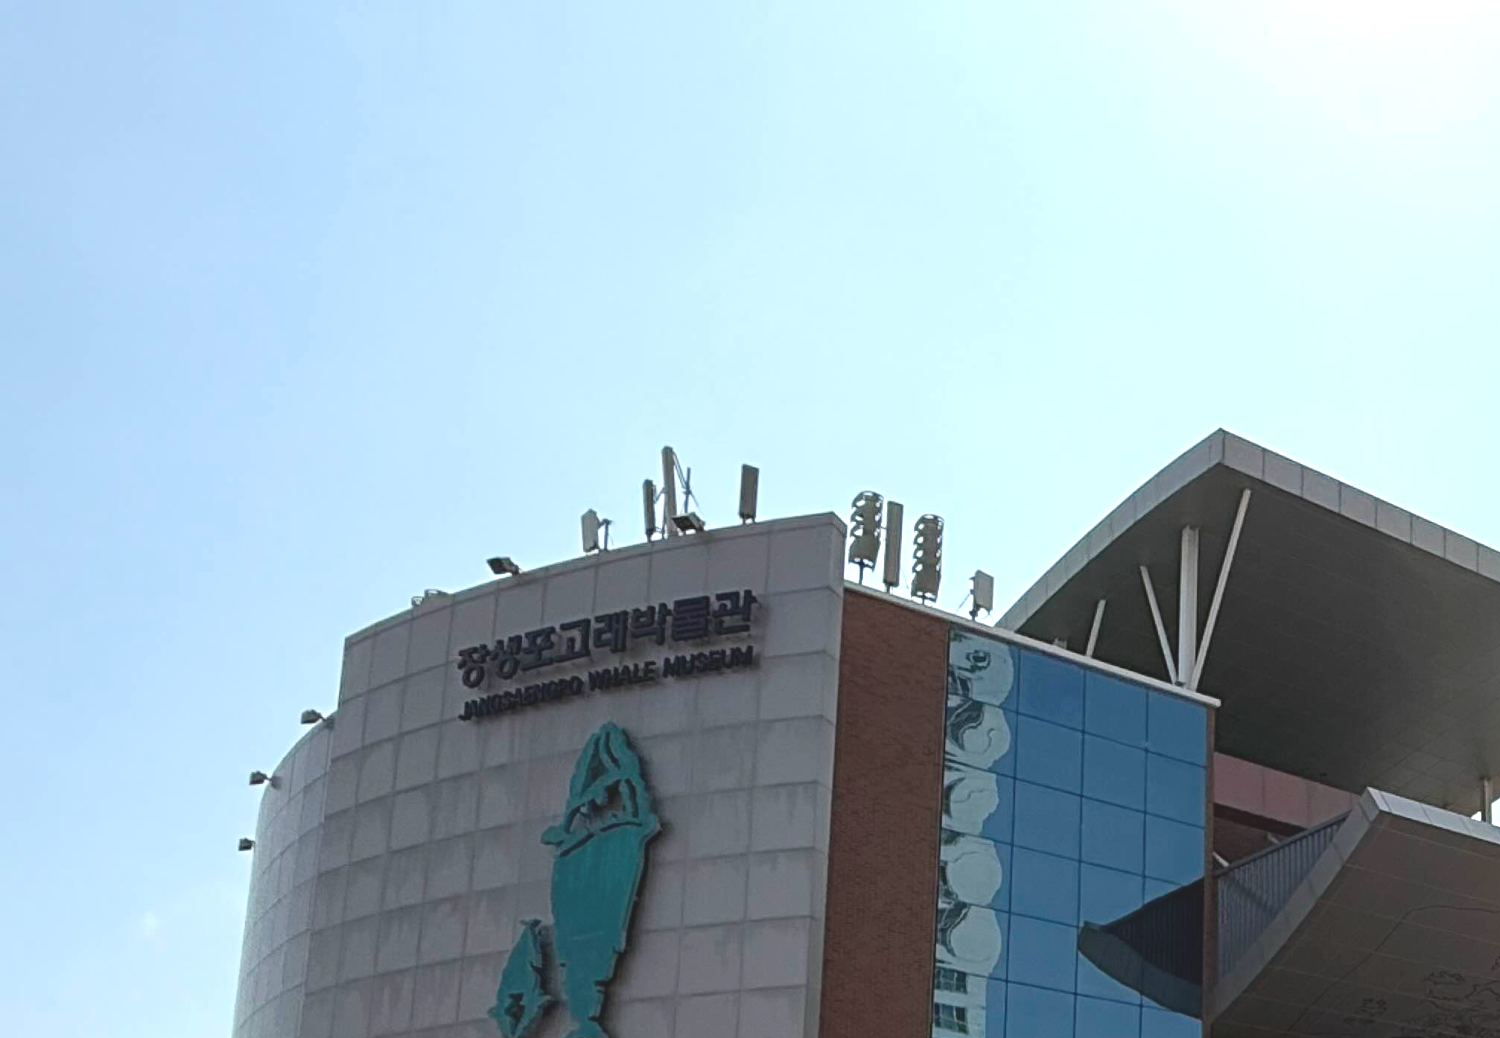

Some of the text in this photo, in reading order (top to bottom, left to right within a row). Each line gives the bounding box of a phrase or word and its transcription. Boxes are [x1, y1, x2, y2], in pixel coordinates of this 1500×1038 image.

[457, 589, 758, 689] 장생포고래박물관
[458, 645, 755, 721] JANGSAENGPO WHALE MUSEUM
